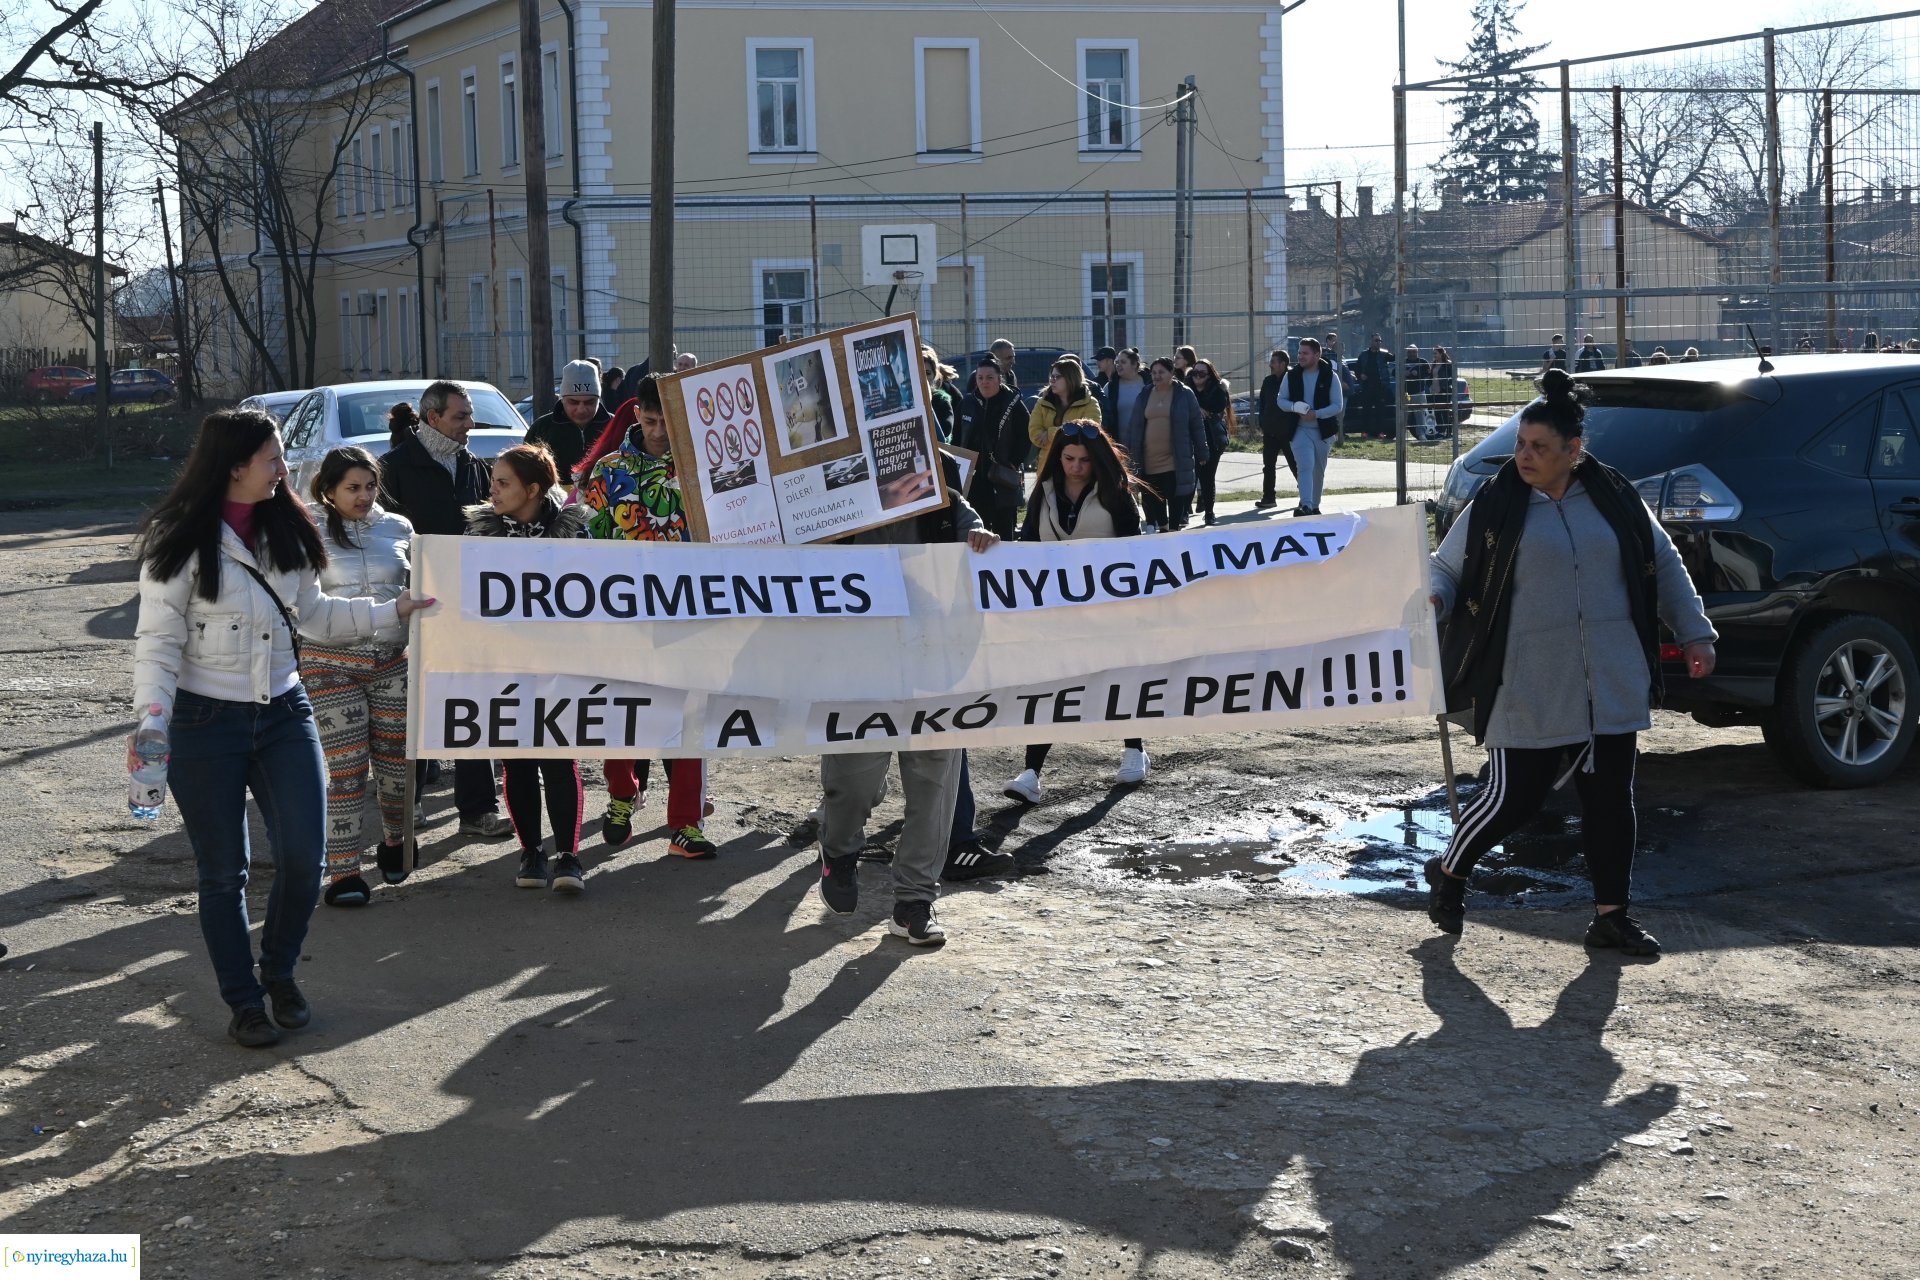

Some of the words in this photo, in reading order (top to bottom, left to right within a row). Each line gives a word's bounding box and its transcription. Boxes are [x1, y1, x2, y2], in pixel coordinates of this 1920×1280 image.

[872, 418, 916, 440] Rászokni
[875, 437, 915, 458] leszokni
[877, 450, 912, 467] nagyon
[880, 460, 908, 476] nehéz
[783, 473, 806, 489] STOP
[725, 495, 748, 511] STOP
[785, 486, 813, 504] DÍLER!
[792, 499, 847, 522] NYUGALMAT
[848, 497, 855, 507] A
[711, 522, 767, 544] NYUGALMAT
[769, 520, 776, 529] A
[795, 509, 864, 536] CSALÁDOKNAK!!
[479, 570, 872, 619] DROGMENTES
[443, 683, 652, 749] BÉKÉT
[716, 709, 762, 748] A
